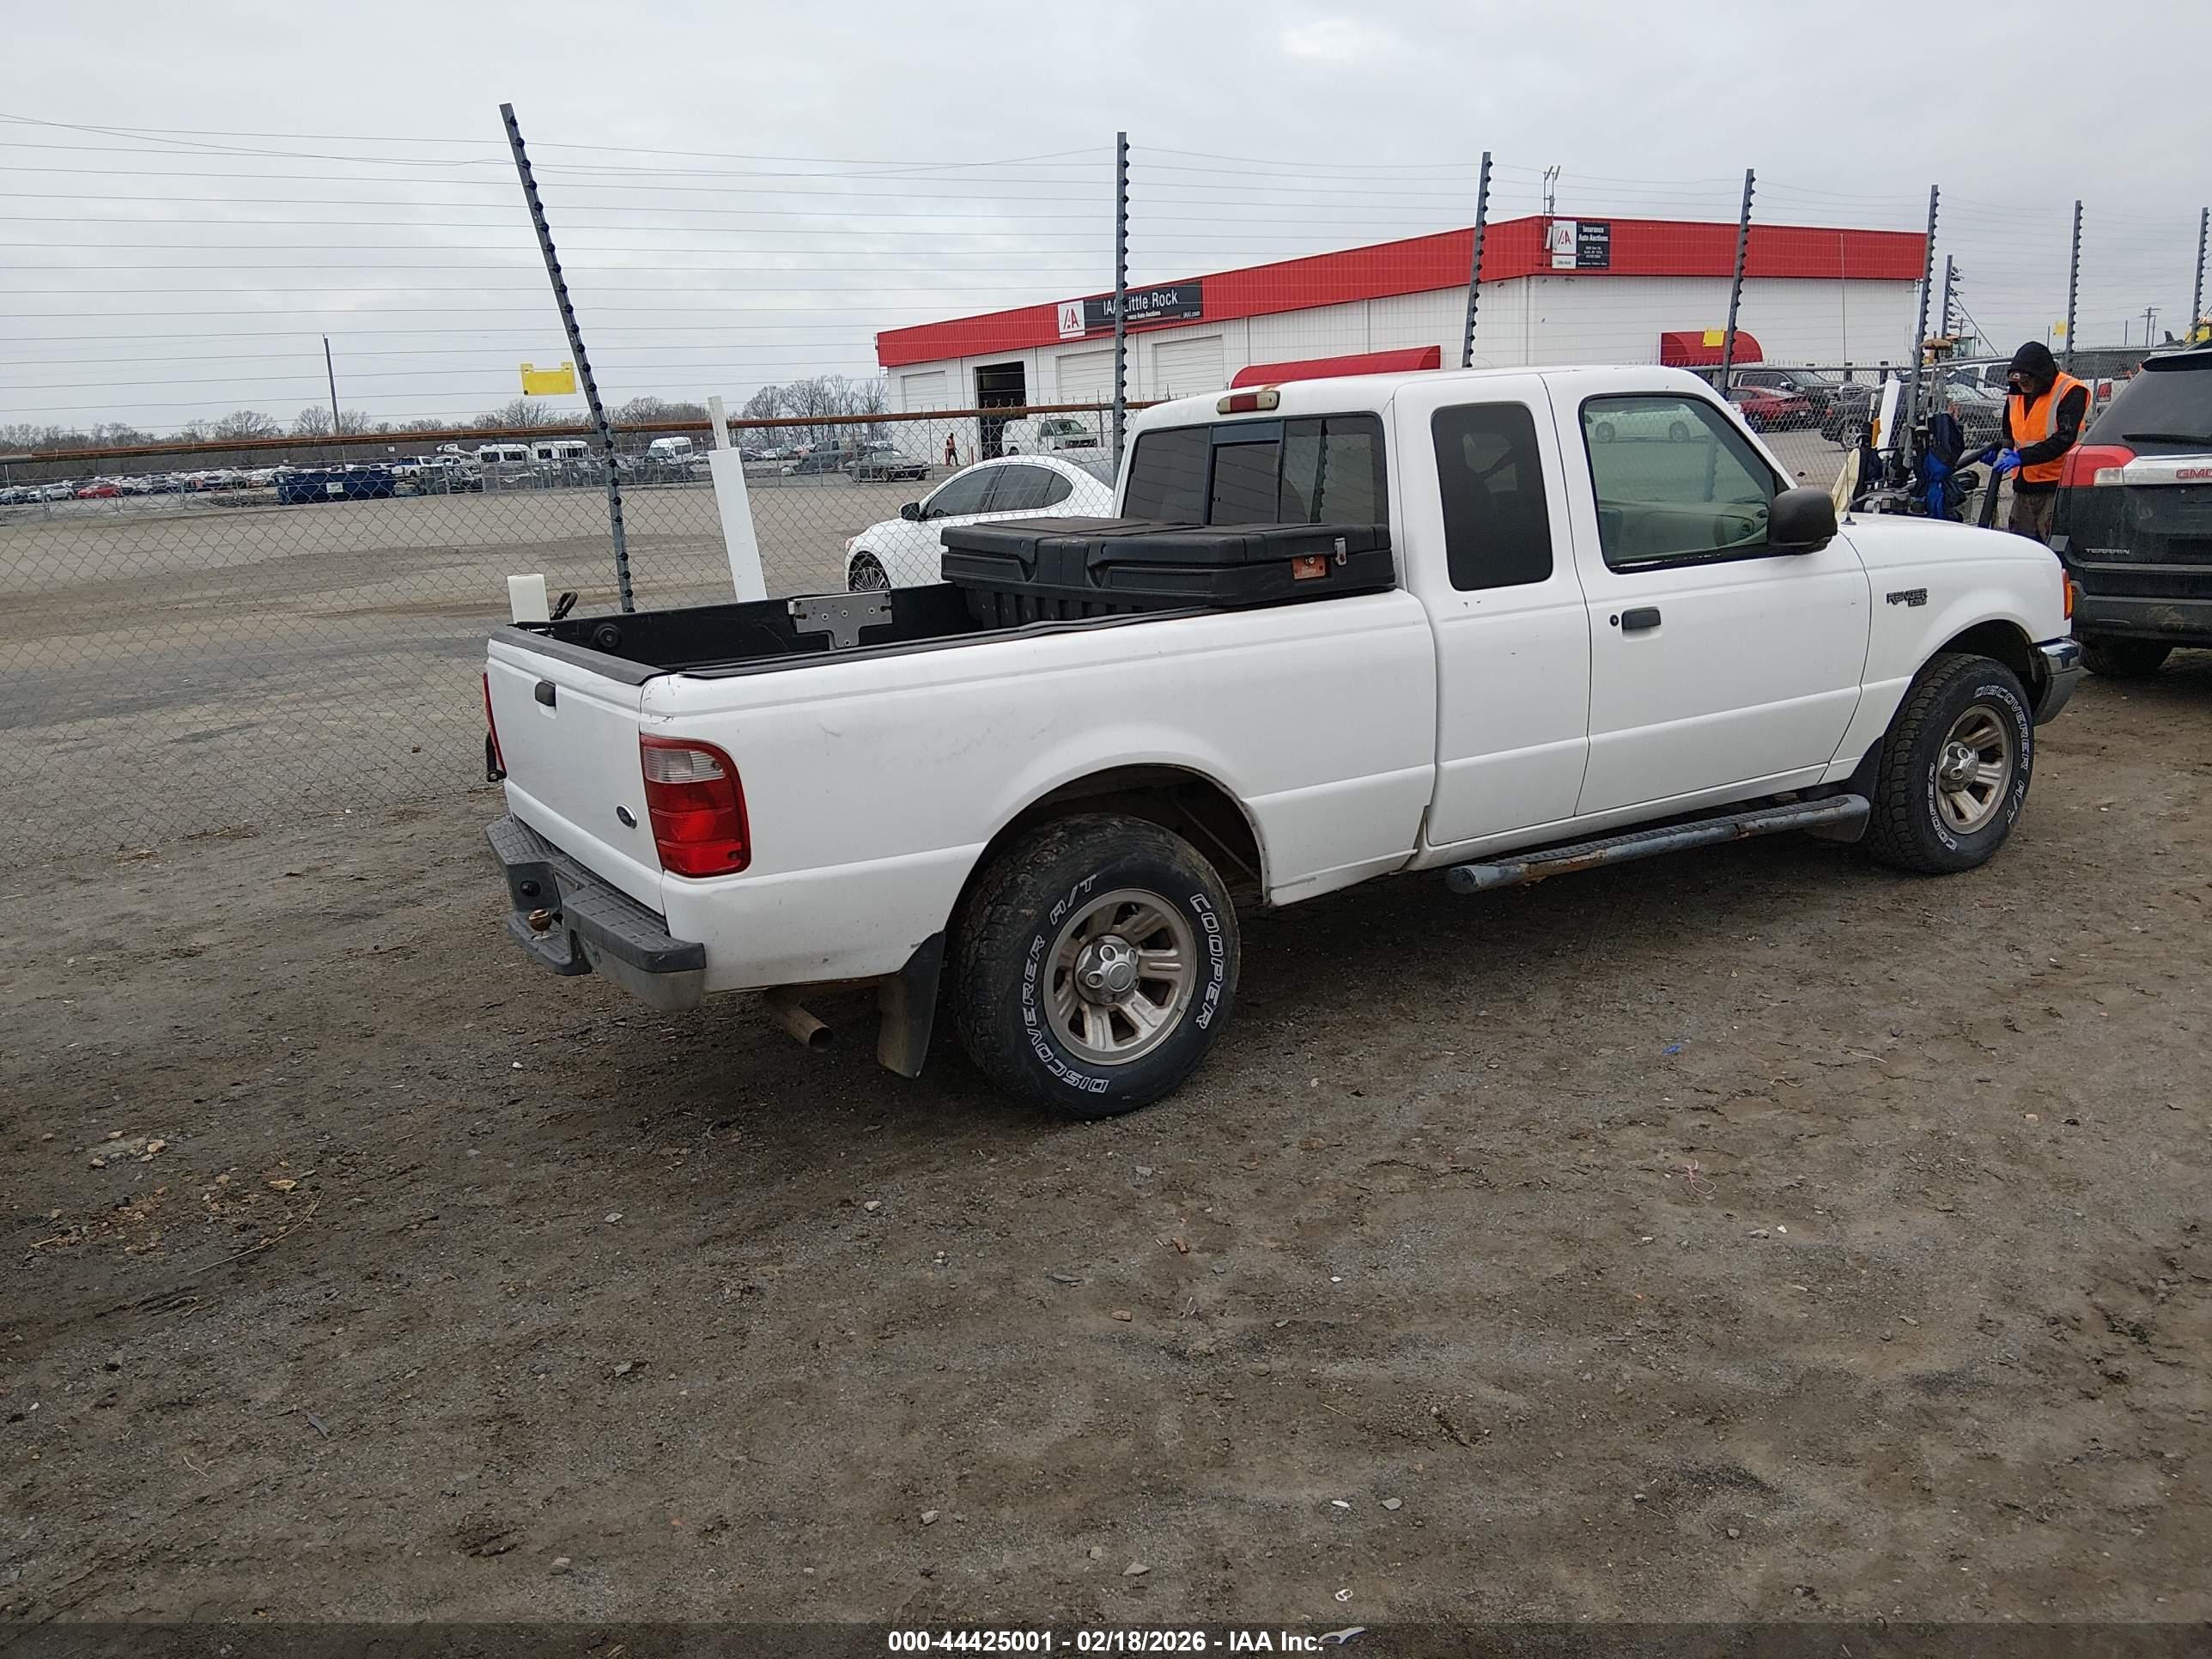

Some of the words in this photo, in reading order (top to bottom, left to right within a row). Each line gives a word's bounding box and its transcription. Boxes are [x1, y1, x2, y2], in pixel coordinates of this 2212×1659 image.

[1152, 289, 1178, 307] Rock
[1973, 685, 2030, 770] DISCOVERER
[1928, 762, 1958, 851] COOPER
[1049, 874, 1097, 926] A/T
[1189, 893, 1224, 1030] COOPER
[1022, 935, 1109, 1093] DISCOVERER
